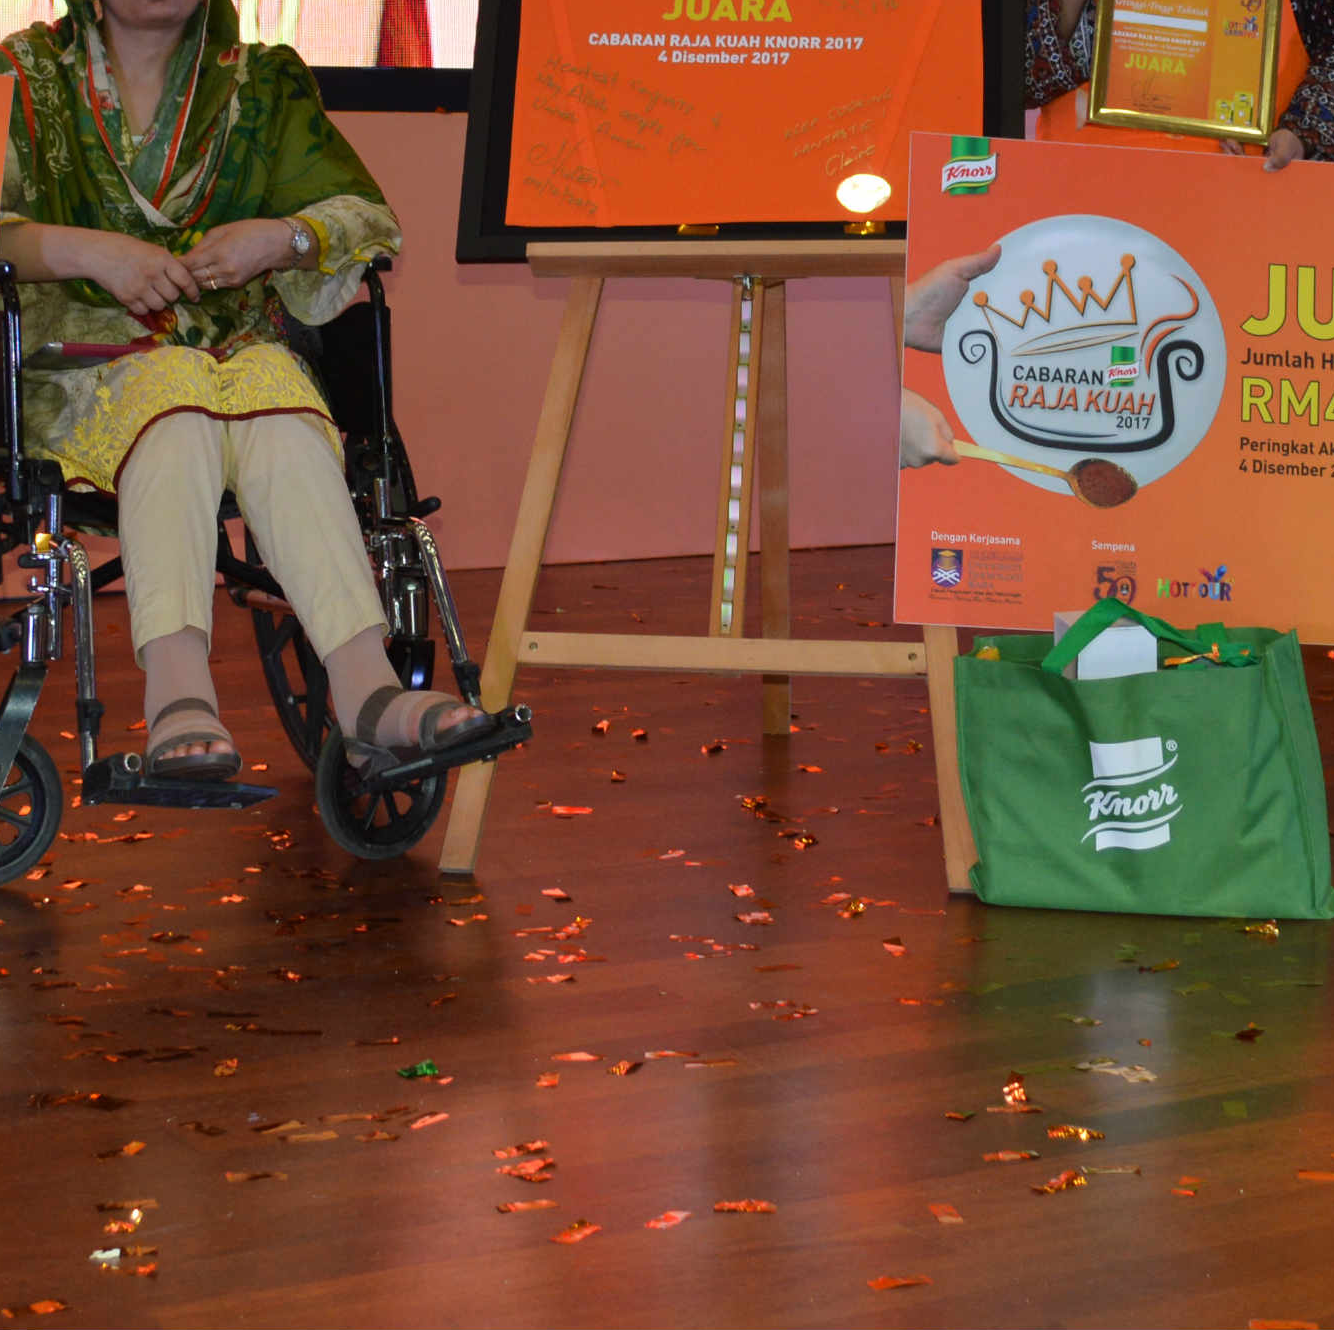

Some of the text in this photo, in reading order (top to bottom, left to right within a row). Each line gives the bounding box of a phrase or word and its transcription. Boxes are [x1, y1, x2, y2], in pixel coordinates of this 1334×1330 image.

[588, 33, 864, 50] CABARAN RAJA KUAH KNORR 2017
[657, 51, 790, 65] 4 Disember 2017
[1124, 54, 1187, 76] JUARA
[945, 164, 994, 182] Knorr
[1240, 347, 1315, 371] Jumlah
[1012, 365, 1139, 386] CABARAN Knorr
[1008, 383, 1156, 417] RAJA KUAH
[1115, 414, 1152, 430] 2017
[1239, 436, 1315, 457] Peringkat
[1238, 458, 1248, 474] 4
[1252, 458, 1327, 478] Disember
[931, 530, 1021, 547] Dengan Kerjasama
[1091, 540, 1136, 553] Sempena
[1083, 783, 1179, 821] Knorr
